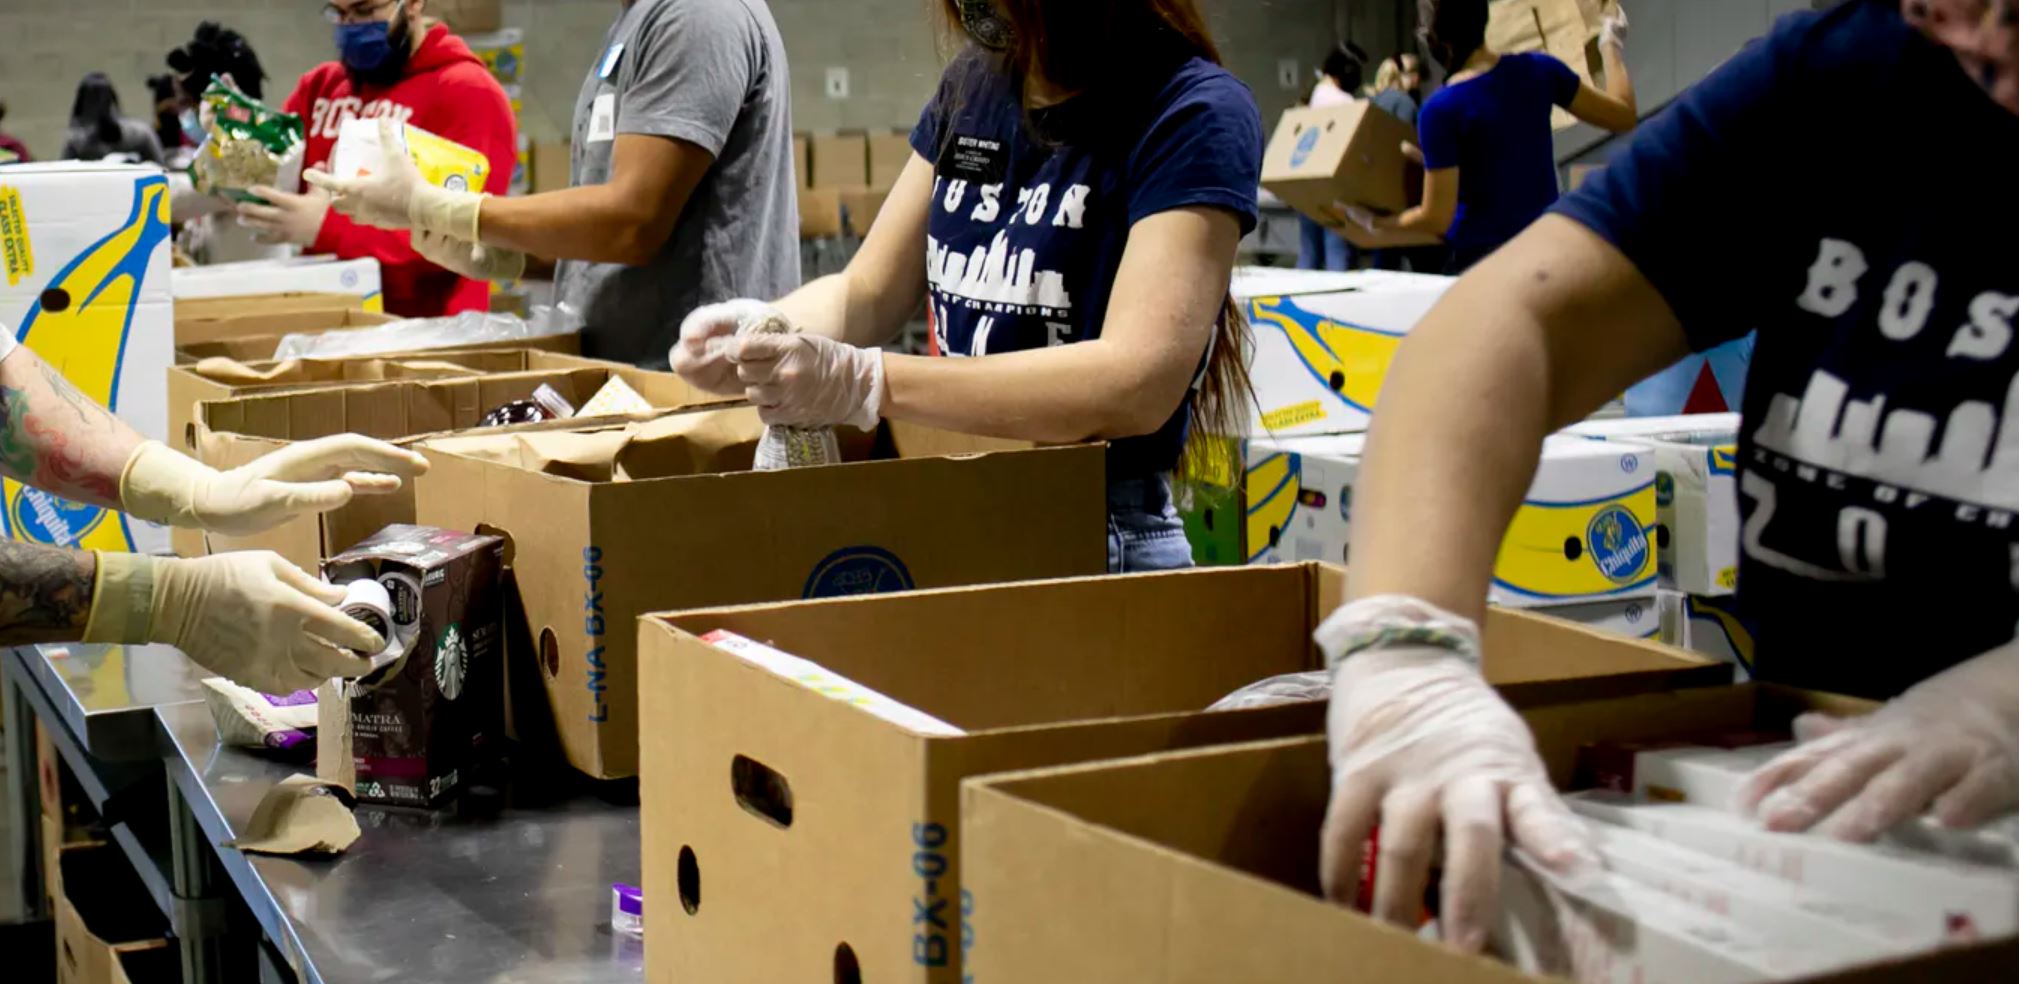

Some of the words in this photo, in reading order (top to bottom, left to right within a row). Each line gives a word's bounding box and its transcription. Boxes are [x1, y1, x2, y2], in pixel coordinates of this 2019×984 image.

[965, 299, 1069, 318] CHAMPIONS
[1753, 448, 1847, 491] ZONE
[1873, 485, 1929, 509] OF
[1599, 531, 1647, 577] Chiquita
[582, 545, 606, 637] BX-06
[912, 822, 948, 968] BX-06
